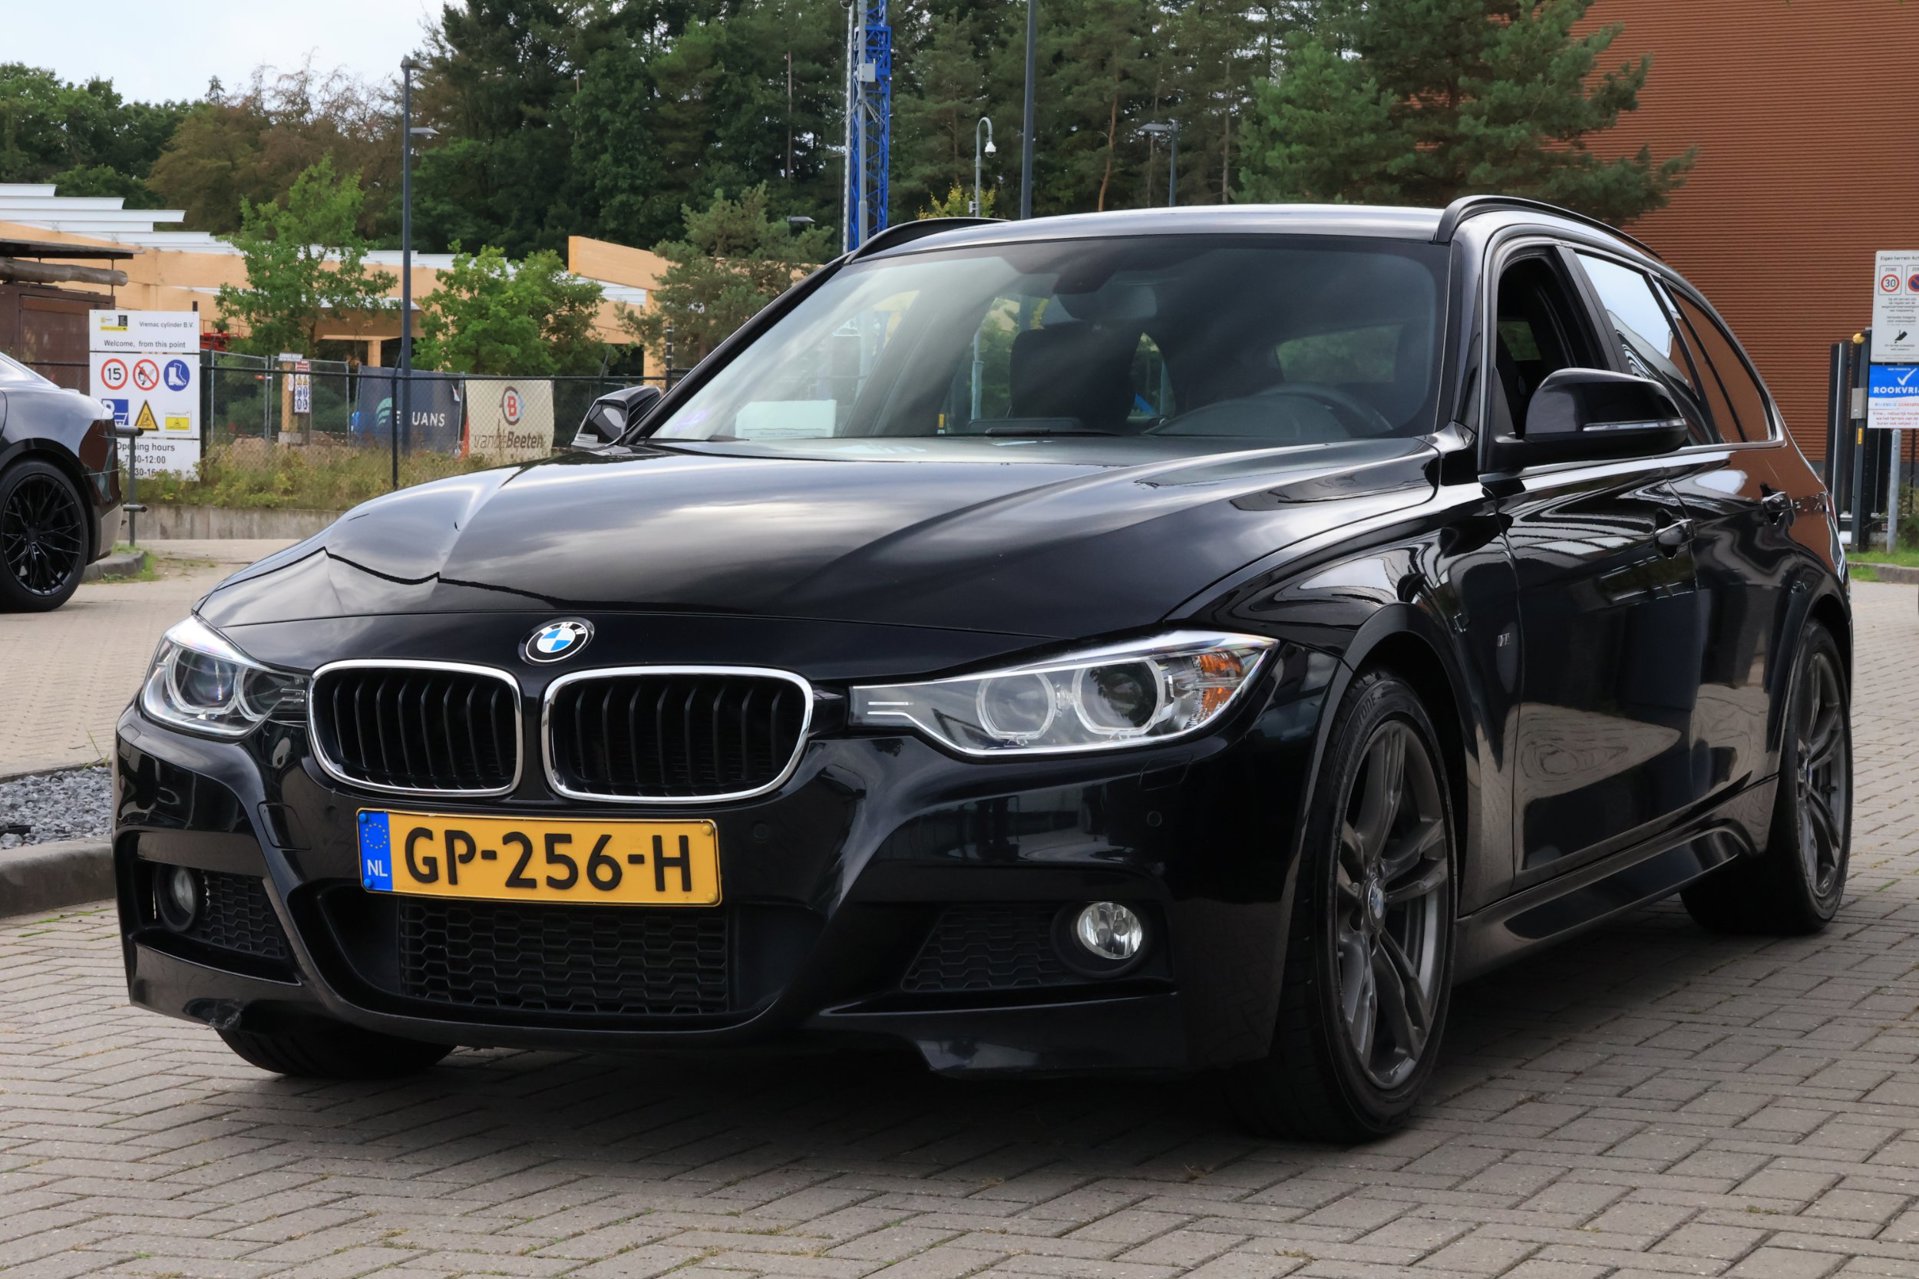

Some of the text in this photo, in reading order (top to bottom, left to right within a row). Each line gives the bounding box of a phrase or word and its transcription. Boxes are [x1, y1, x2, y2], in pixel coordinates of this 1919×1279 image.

[1885, 278, 1896, 288] 30
[160, 321, 182, 329] cylinder
[104, 339, 186, 349] Welcome, from this point
[107, 367, 122, 381] 15
[507, 396, 517, 417] B
[396, 410, 446, 427] EUANS
[151, 442, 176, 452] hours
[404, 827, 693, 892] GP-256-H
[367, 859, 388, 878] NL
